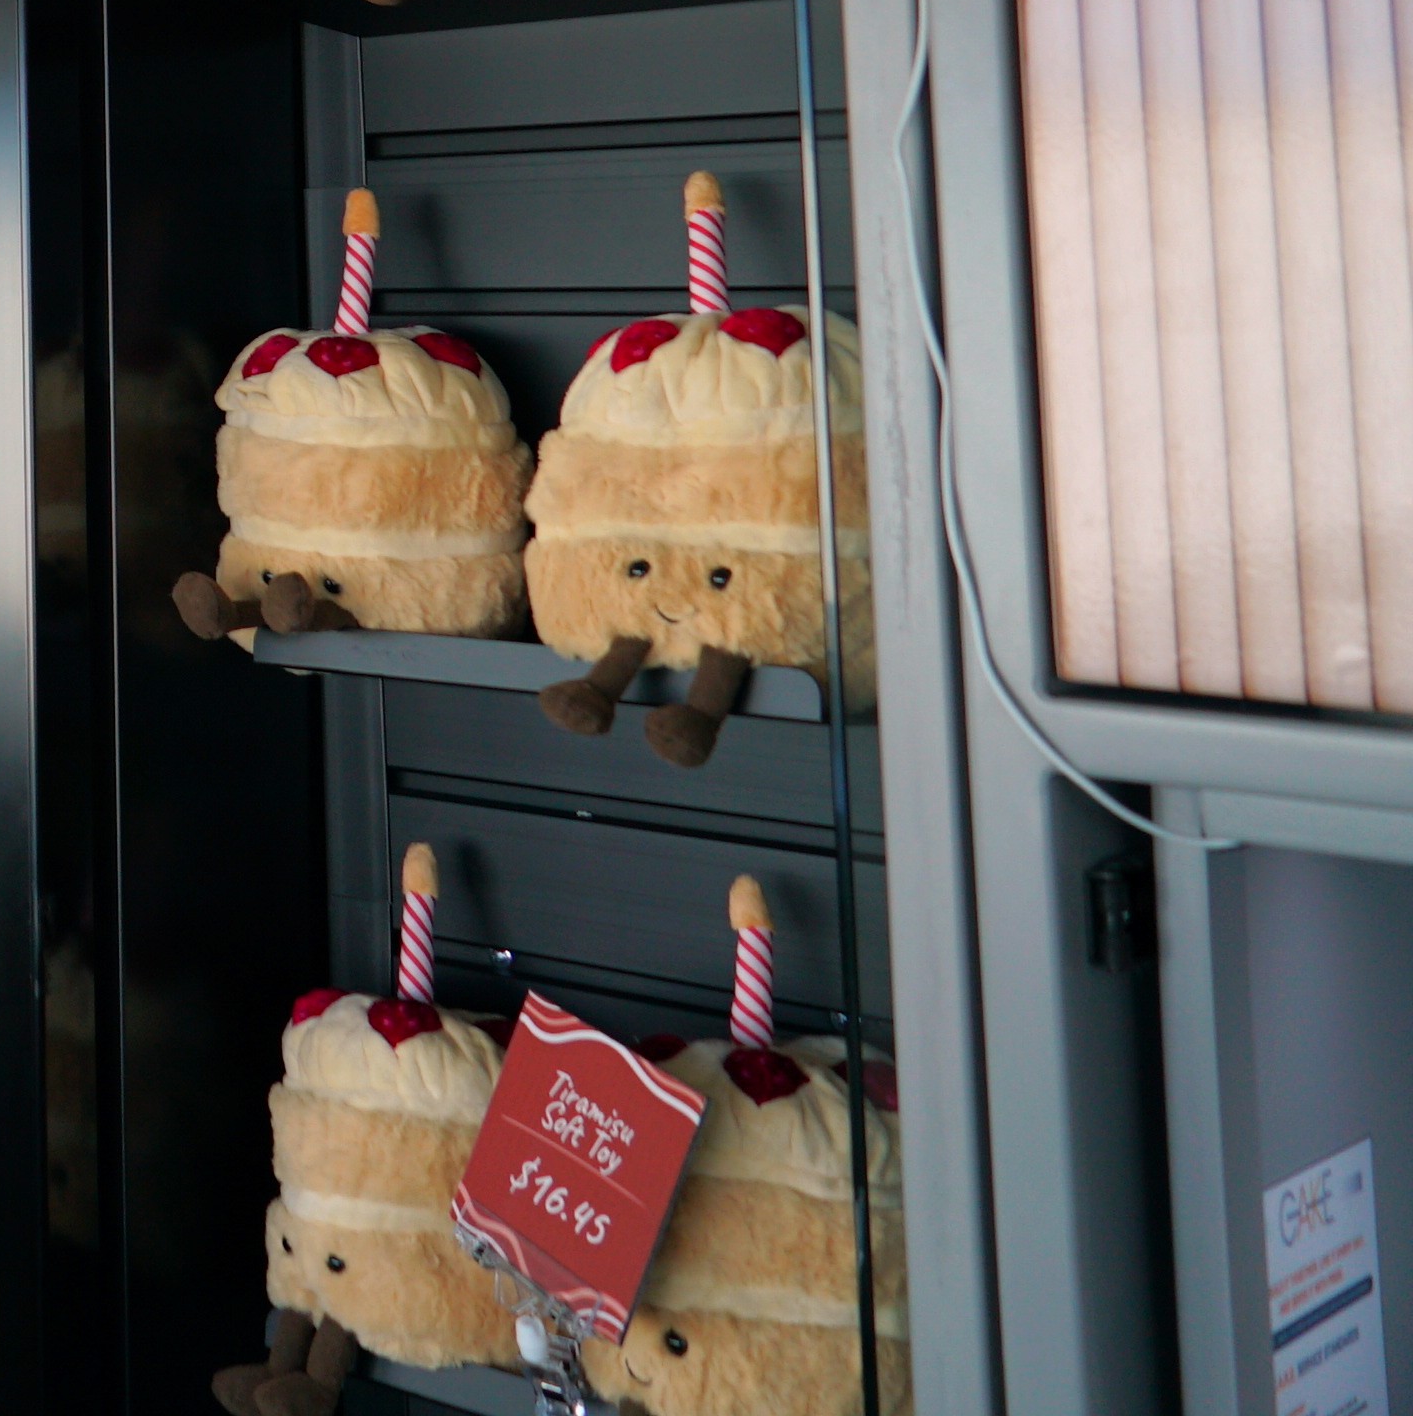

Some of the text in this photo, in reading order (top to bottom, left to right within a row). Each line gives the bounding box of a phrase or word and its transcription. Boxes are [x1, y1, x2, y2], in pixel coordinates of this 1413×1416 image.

[541, 1100, 622, 1176] Soft Toy
[547, 1069, 635, 1147] Tiramisu
[510, 1156, 612, 1246] $16.45
